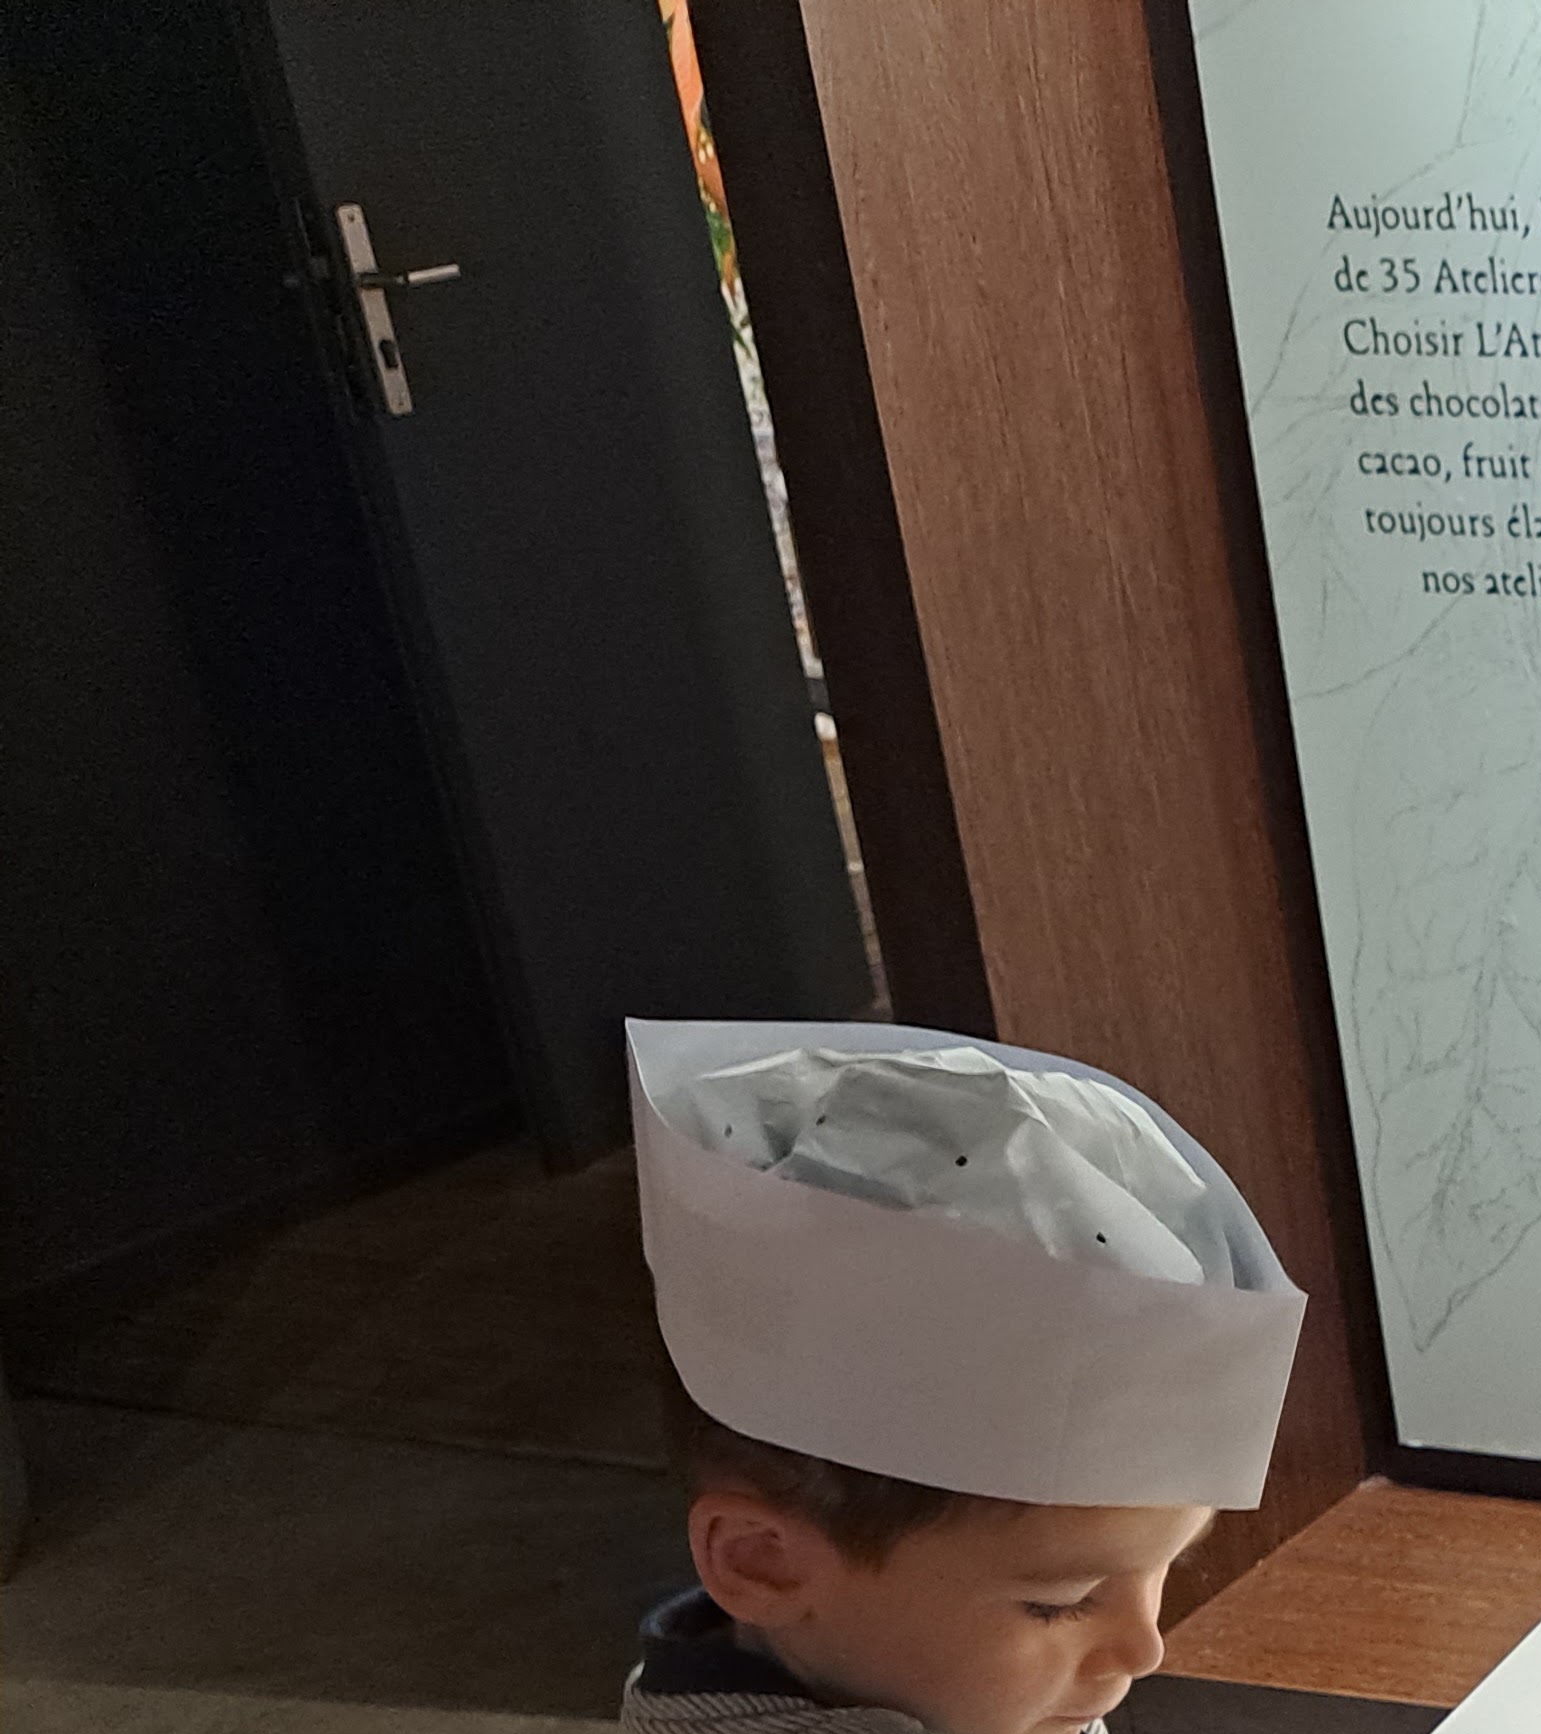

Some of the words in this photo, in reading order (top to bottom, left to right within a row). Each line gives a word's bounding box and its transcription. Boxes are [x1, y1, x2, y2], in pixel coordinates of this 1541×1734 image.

[1326, 191, 1531, 239] Aujourd'hui,
[1334, 254, 1370, 293] de
[1379, 257, 1421, 294] 35
[1343, 316, 1464, 357] Choisir
[1349, 378, 1400, 417] des
[1357, 451, 1452, 484] cacao,
[1462, 441, 1531, 480] fruit
[1364, 501, 1496, 543] toujours
[1421, 571, 1476, 595] nos
